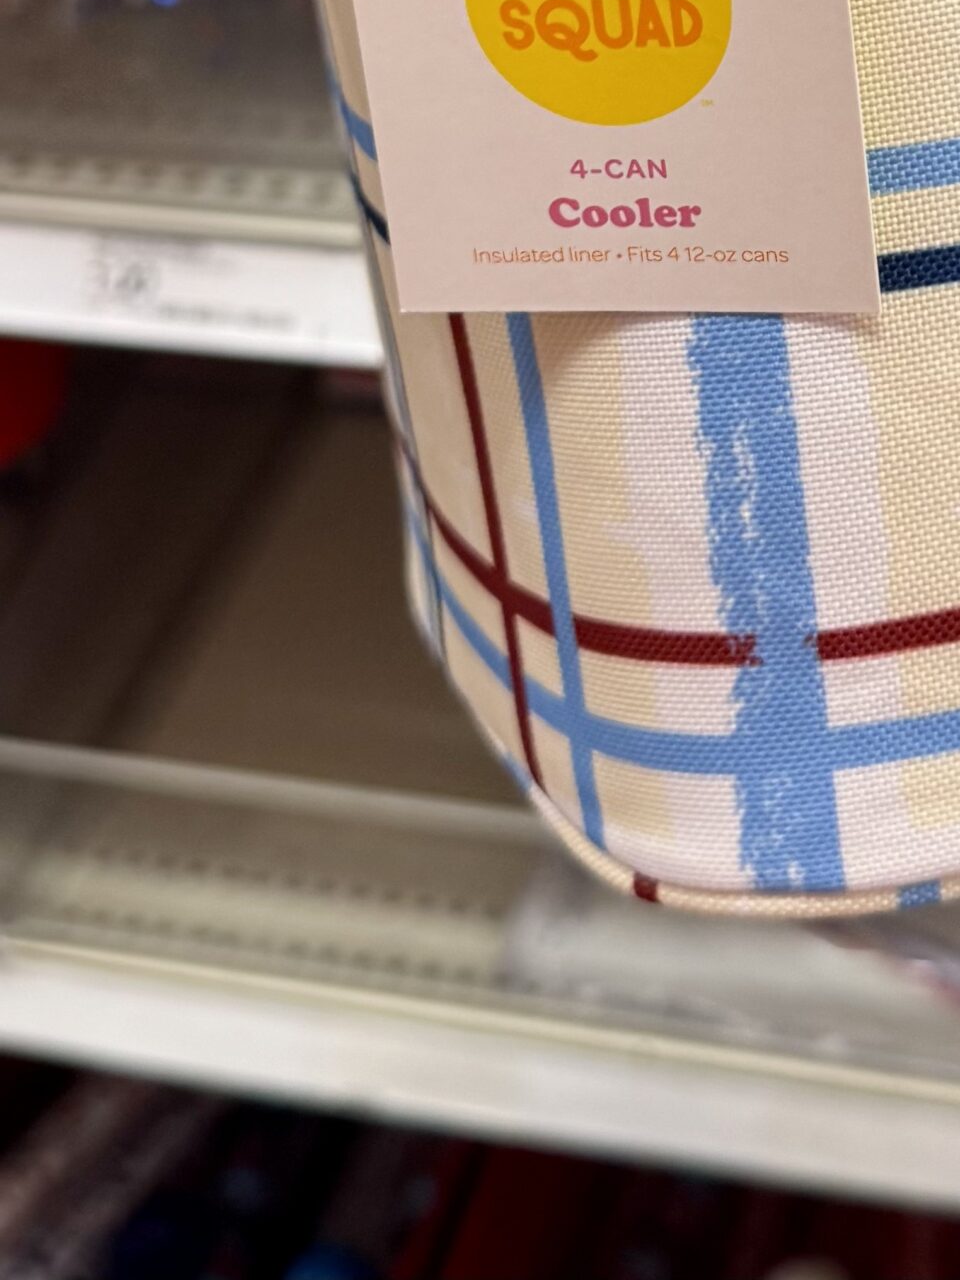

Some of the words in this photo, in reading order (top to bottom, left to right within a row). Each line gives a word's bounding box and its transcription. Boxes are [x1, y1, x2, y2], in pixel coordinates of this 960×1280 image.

[569, 158, 668, 180] 4-CAN
[548, 196, 702, 229] Cooler
[472, 246, 565, 265] Insulated
[569, 245, 611, 263] liner
[627, 245, 663, 263] Fits
[667, 246, 680, 262] 4
[684, 246, 738, 263] 12-oz
[741, 249, 789, 263] cans
